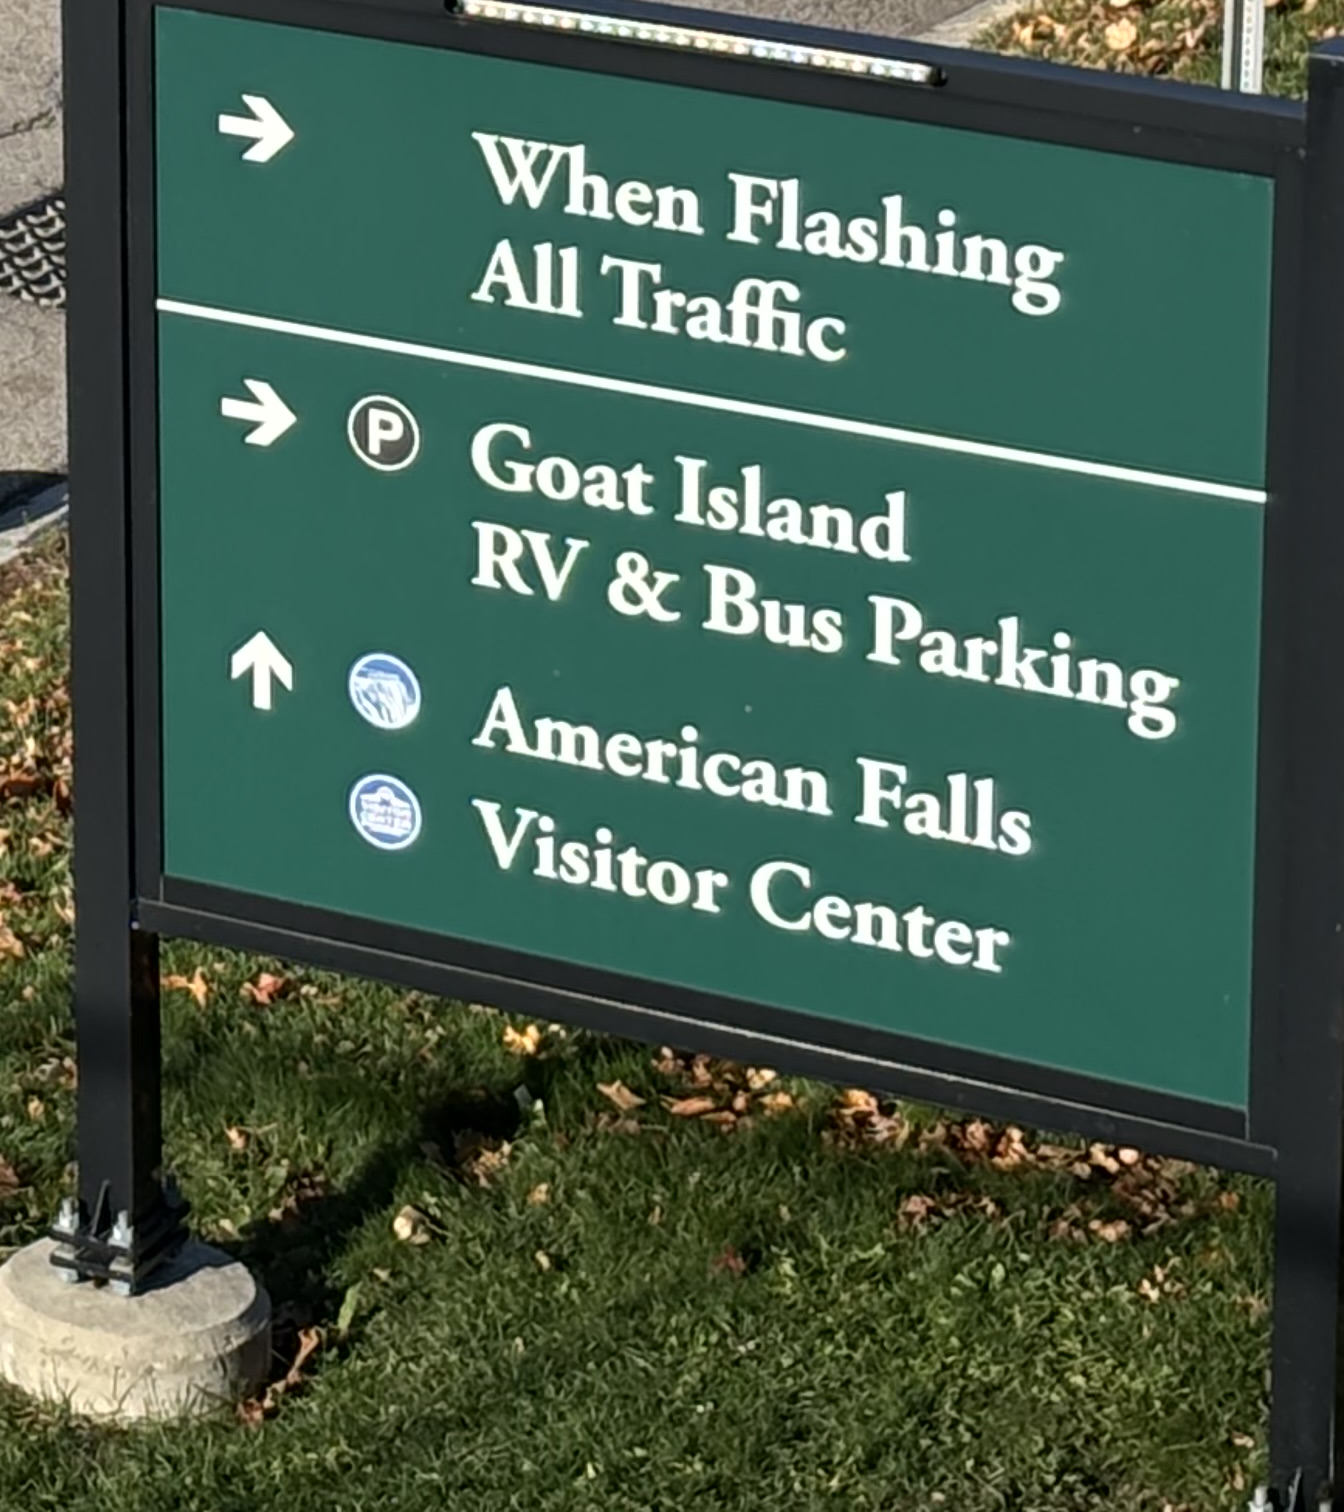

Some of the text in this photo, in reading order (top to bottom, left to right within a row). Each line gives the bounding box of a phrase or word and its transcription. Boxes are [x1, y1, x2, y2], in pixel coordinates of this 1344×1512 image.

[471, 239, 845, 361] All Traffic
[472, 132, 1064, 315] When Flashing
[369, 408, 403, 455] P
[472, 423, 911, 561] Goat Island
[472, 522, 1179, 739] RV & Bus Parking
[472, 687, 1031, 855] American Falls
[472, 799, 1009, 972] Visitor Center
